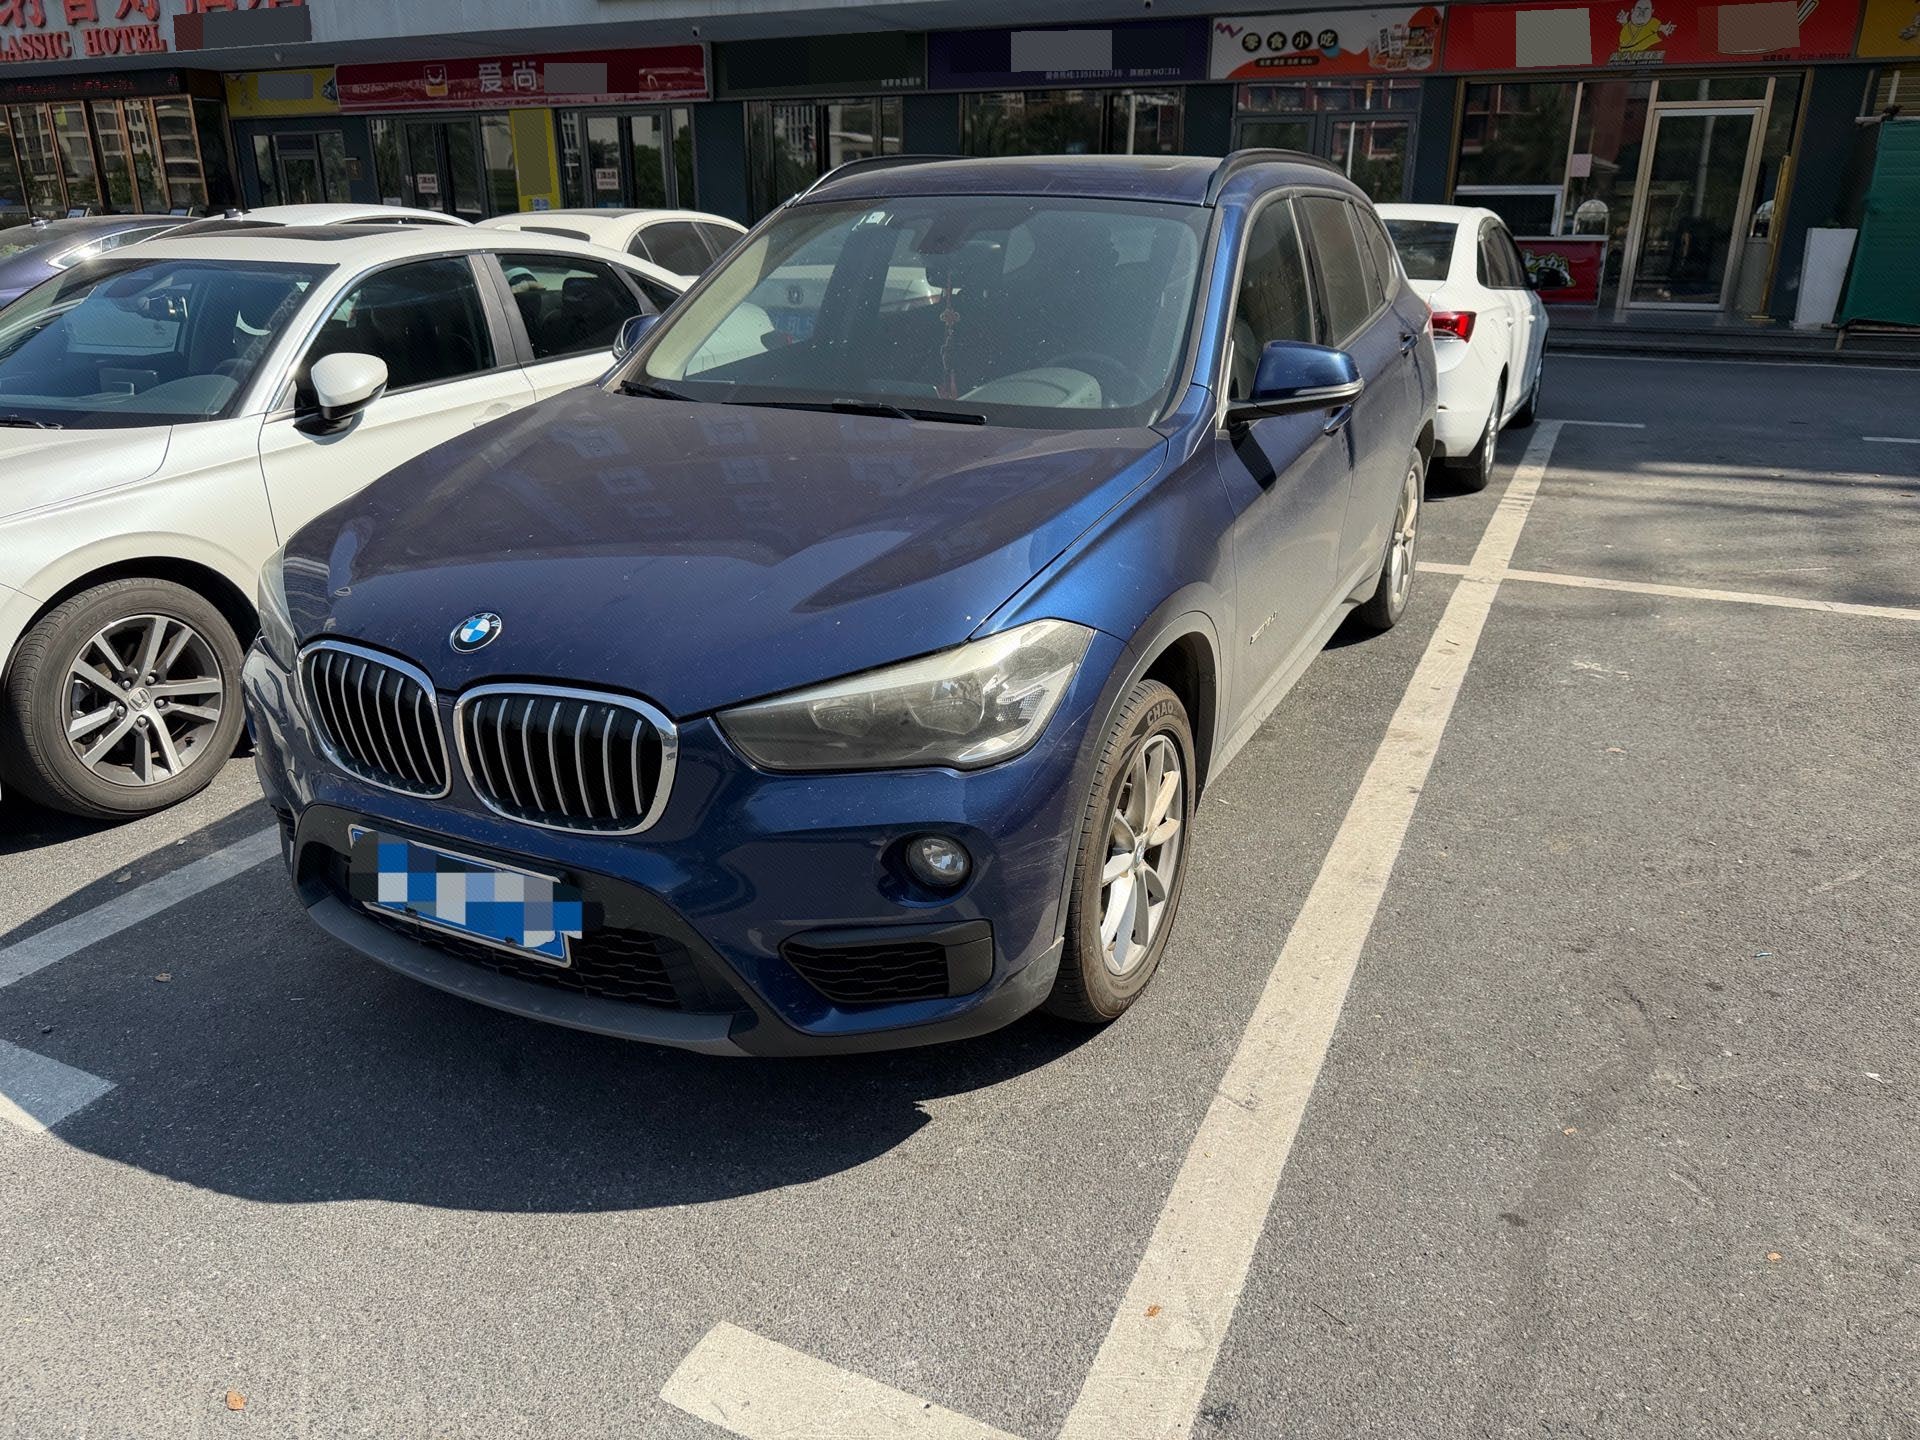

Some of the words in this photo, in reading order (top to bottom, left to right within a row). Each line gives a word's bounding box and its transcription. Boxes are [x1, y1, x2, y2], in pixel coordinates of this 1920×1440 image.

[82, 25, 167, 56] HOTEL
[1244, 32, 1337, 50] 零食小吃
